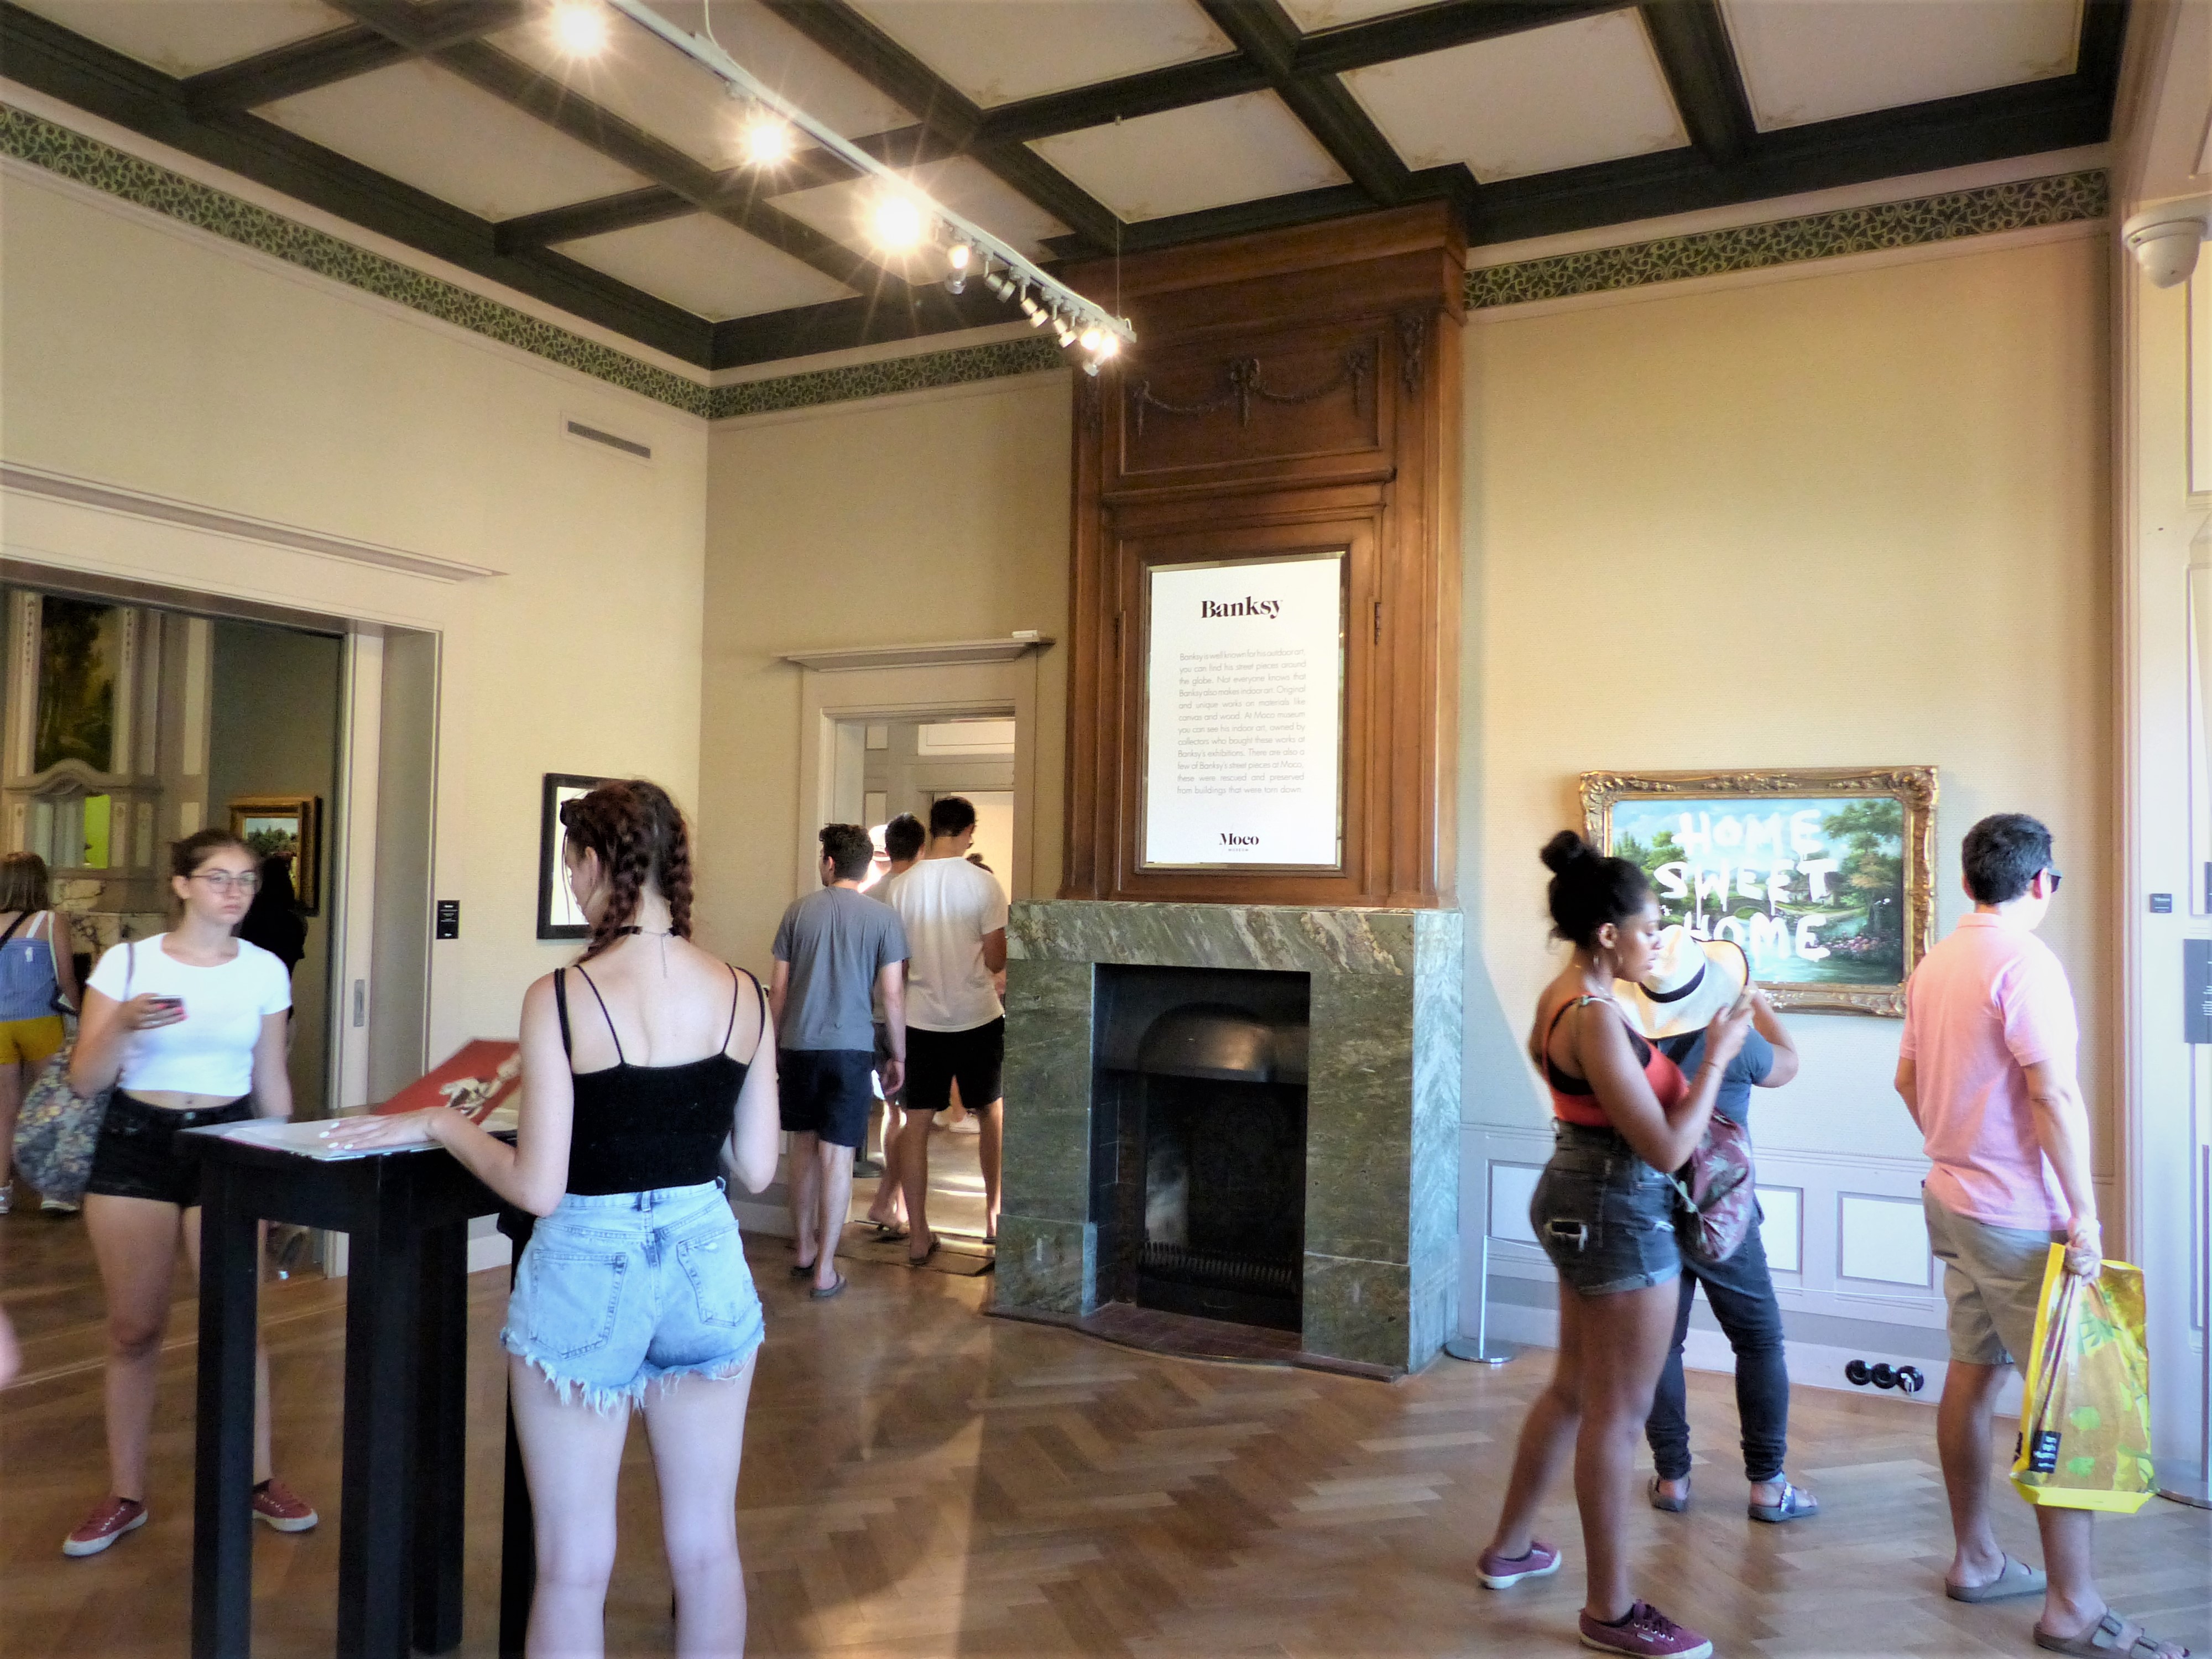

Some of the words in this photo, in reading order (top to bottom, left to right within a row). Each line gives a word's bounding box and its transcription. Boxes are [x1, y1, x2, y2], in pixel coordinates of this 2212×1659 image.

[1201, 596, 1281, 619] Banksy
[1180, 653, 1202, 662] Banksy
[1267, 648, 1293, 656] outdoor
[1192, 677, 1214, 686] globe.
[1179, 690, 1202, 698] Banksy
[1276, 684, 1306, 695] Original
[1196, 701, 1218, 709] unique
[1259, 698, 1290, 706] materials
[1296, 723, 1305, 732] by
[1229, 737, 1253, 745] bought
[1178, 749, 1206, 759] Banksy's
[1199, 761, 1228, 771] Banksy's
[1280, 760, 1303, 769] Moco,
[1270, 773, 1305, 782] preserved
[1177, 786, 1192, 794] from
[1194, 786, 1226, 795] buildings
[1671, 808, 1823, 857] HOME
[1219, 833, 1259, 846] Moco
[1654, 858, 1839, 912] SWEET
